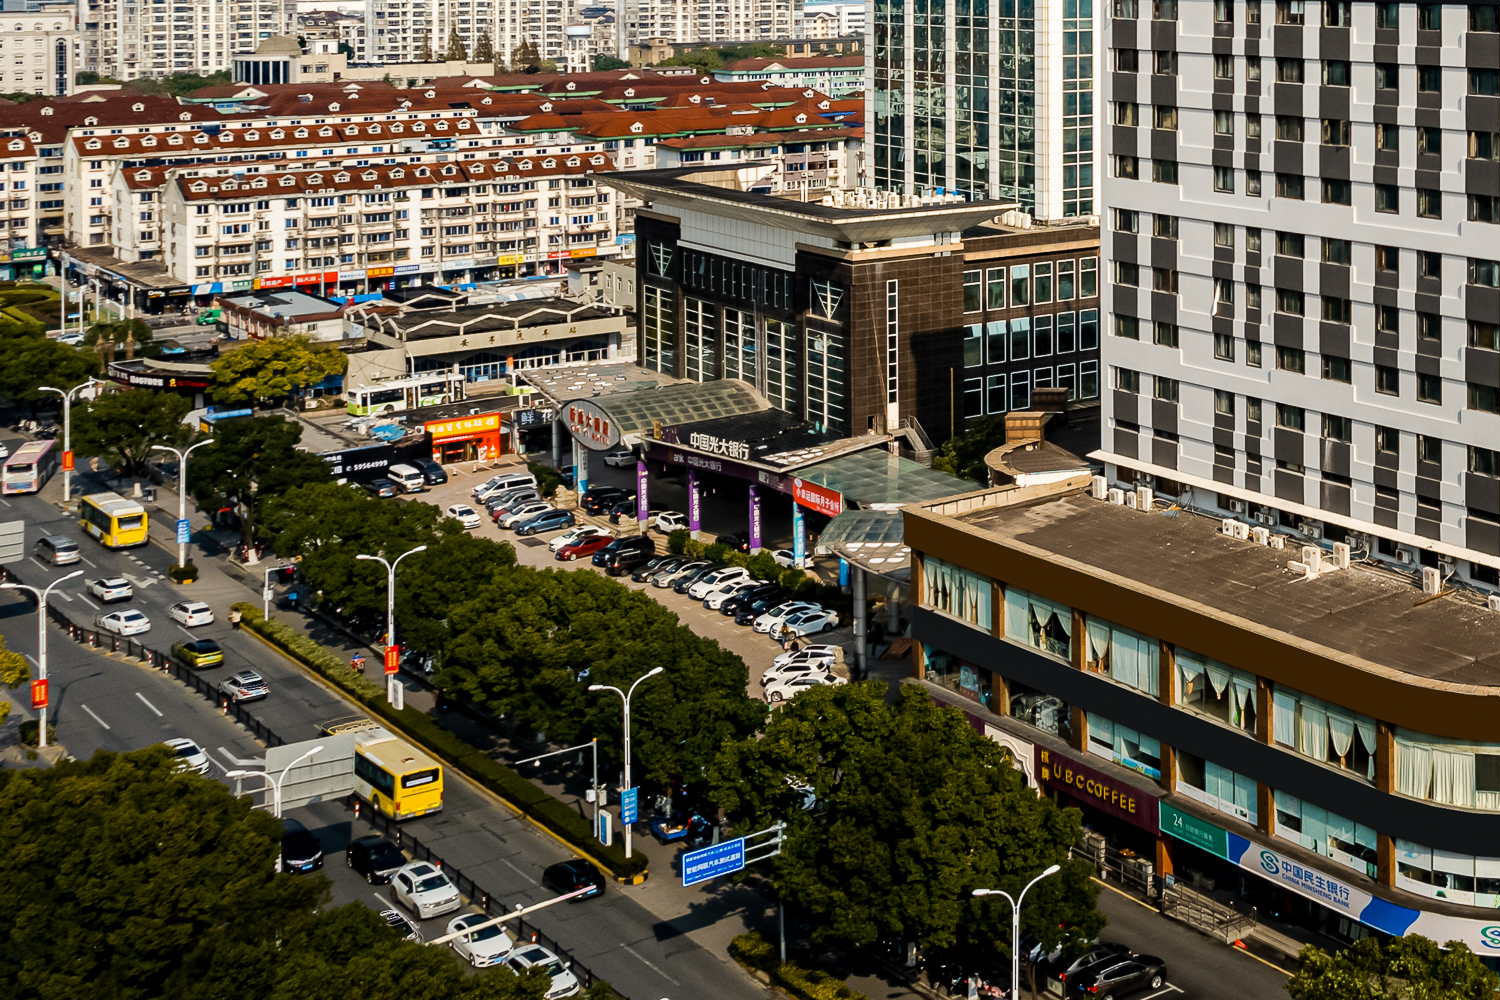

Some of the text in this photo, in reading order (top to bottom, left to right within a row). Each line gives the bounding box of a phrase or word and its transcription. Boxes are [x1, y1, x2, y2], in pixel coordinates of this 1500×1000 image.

[460, 325, 577, 347] 安亭汽车站
[521, 408, 552, 425] 鲜花
[690, 432, 749, 461] 中国光大银行
[687, 456, 722, 472] 中国光大银行
[1040, 749, 1050, 782] 棋牌
[1086, 779, 1136, 814] COFFEE
[1173, 813, 1183, 828] 24
[1281, 860, 1350, 901] 中国民生银行
[1281, 873, 1350, 909] CHINA MINSHENG BANK
